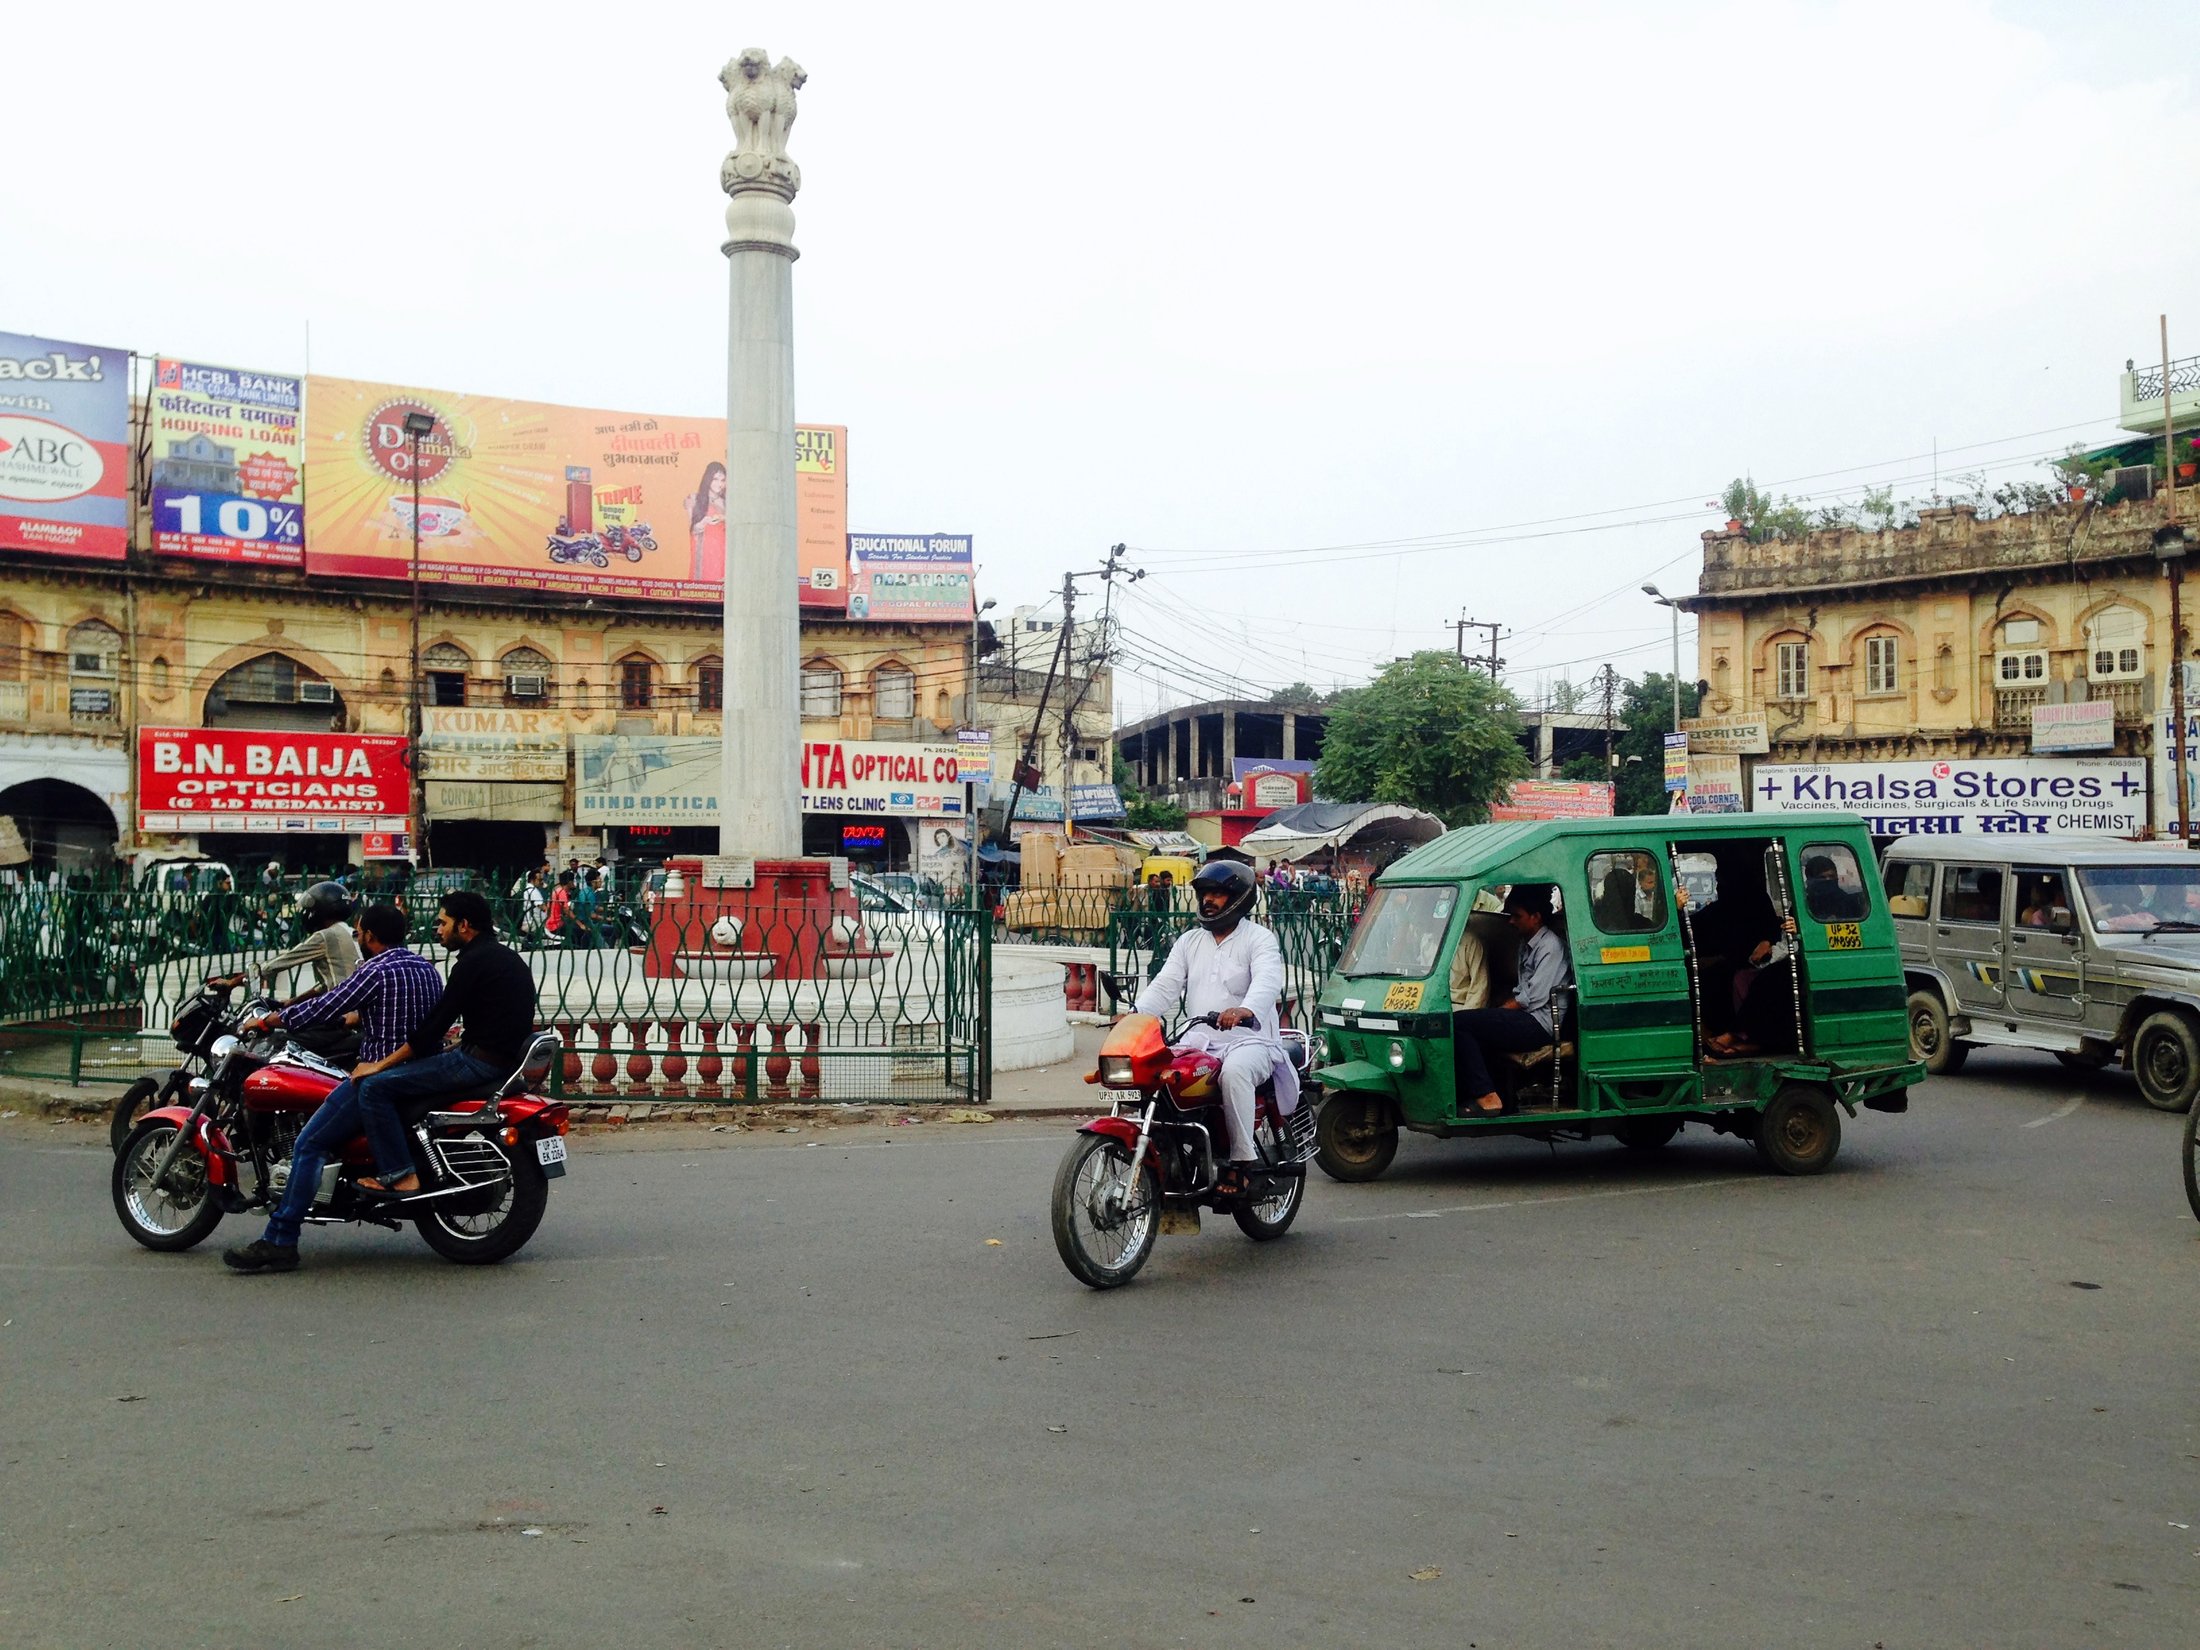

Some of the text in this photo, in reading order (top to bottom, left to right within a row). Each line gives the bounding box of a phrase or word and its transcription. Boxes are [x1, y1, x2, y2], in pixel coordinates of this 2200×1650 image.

[182, 368, 296, 395] HCBL BANK
[237, 389, 262, 400] BANK
[262, 391, 297, 407] LIMITED
[157, 393, 233, 420] फेस्टिवल
[239, 407, 298, 428] धमाका
[161, 417, 297, 446] HOUSING LOAN
[611, 431, 702, 453] दीपावली की
[795, 430, 833, 450] CITI
[11, 436, 83, 468] ABC
[594, 484, 643, 506] TRIPLE
[599, 504, 626, 514] Bumper
[19, 521, 83, 537] ALAMBAGH
[854, 538, 967, 553] EDUCATIONAL FORUM
[1689, 726, 1758, 740] चश्मा घर
[154, 742, 373, 778] B.N. BAIJA
[852, 754, 928, 782] OPTICAL
[1789, 766, 1831, 774] 9415028773
[177, 780, 378, 798] OPTICIANS
[1694, 783, 1732, 795] SANKI
[1793, 771, 2102, 801] Khalsa Stores
[250, 798, 385, 812] MEDALIST)
[584, 796, 634, 809] HIND
[813, 796, 844, 810] LENS
[848, 797, 886, 811] CLINIC
[1687, 796, 1707, 805] COOL
[1781, 798, 2114, 811] Vaccines, Medicines, Surgicals & Life Saving Drugs
[921, 820, 949, 828] CONTACT
[1976, 809, 2052, 834] स्टोर
[2056, 814, 2135, 830] CHEMIST
[1405, 987, 1418, 998] 32
[1099, 1091, 1113, 1100] UP32
